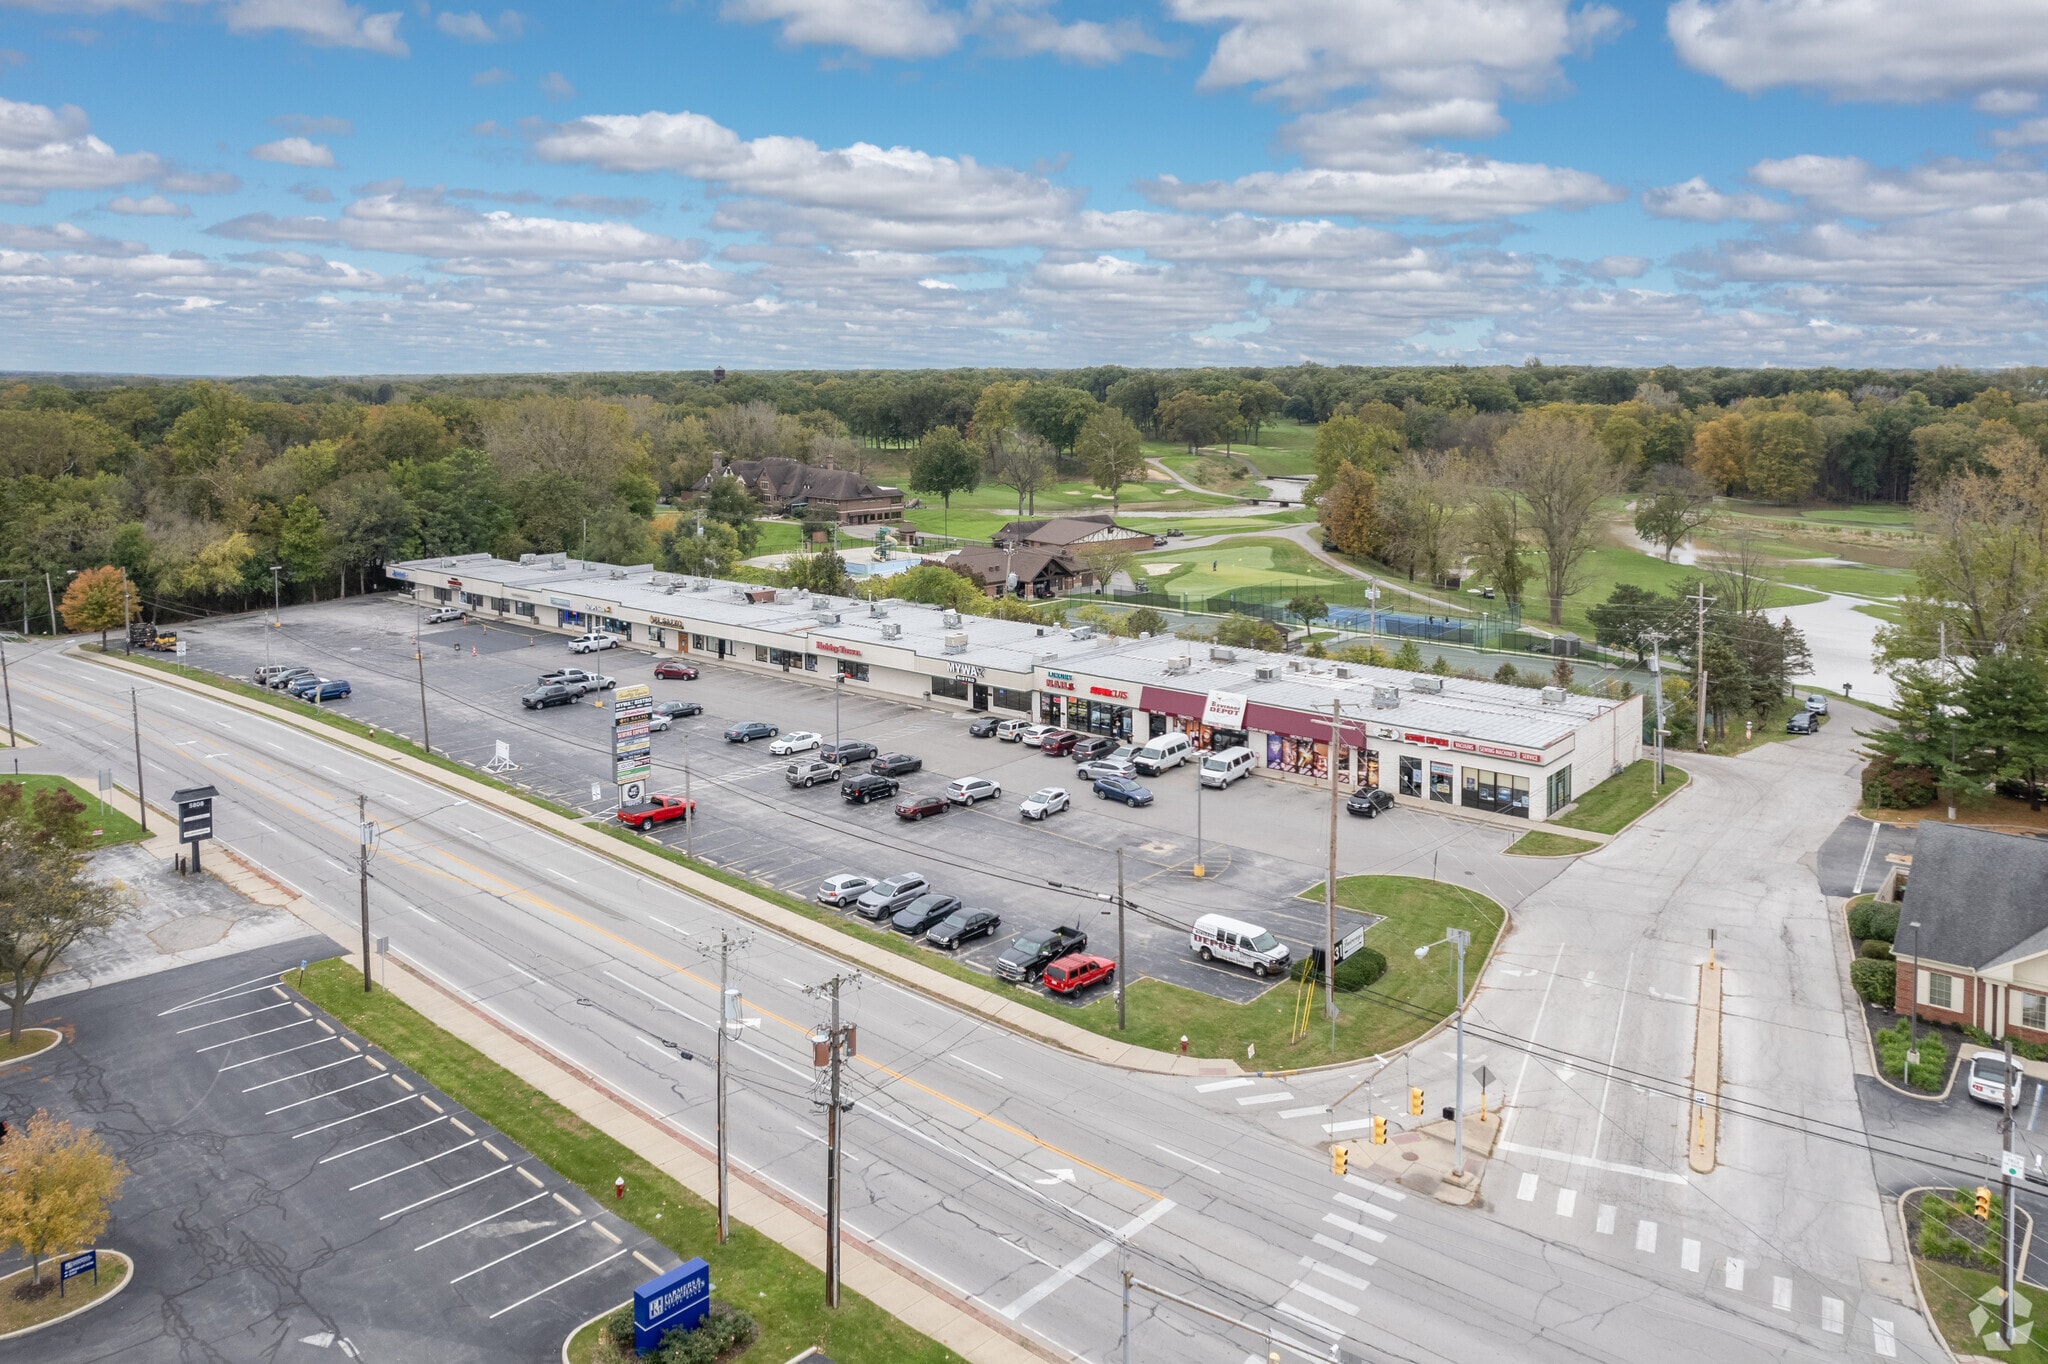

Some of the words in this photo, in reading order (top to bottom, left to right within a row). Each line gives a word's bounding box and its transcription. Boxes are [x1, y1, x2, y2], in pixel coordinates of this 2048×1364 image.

[1045, 679, 1075, 691] NAILS
[1209, 706, 1240, 716] DEPOT
[1211, 701, 1240, 710] BEVERAGE
[1495, 748, 1516, 758] MACHINES
[1521, 752, 1539, 762] SERVICE
[1194, 934, 1234, 952] DEPOT
[664, 1280, 695, 1299] FARMERS
[664, 1280, 705, 1305] MERCHANTS
